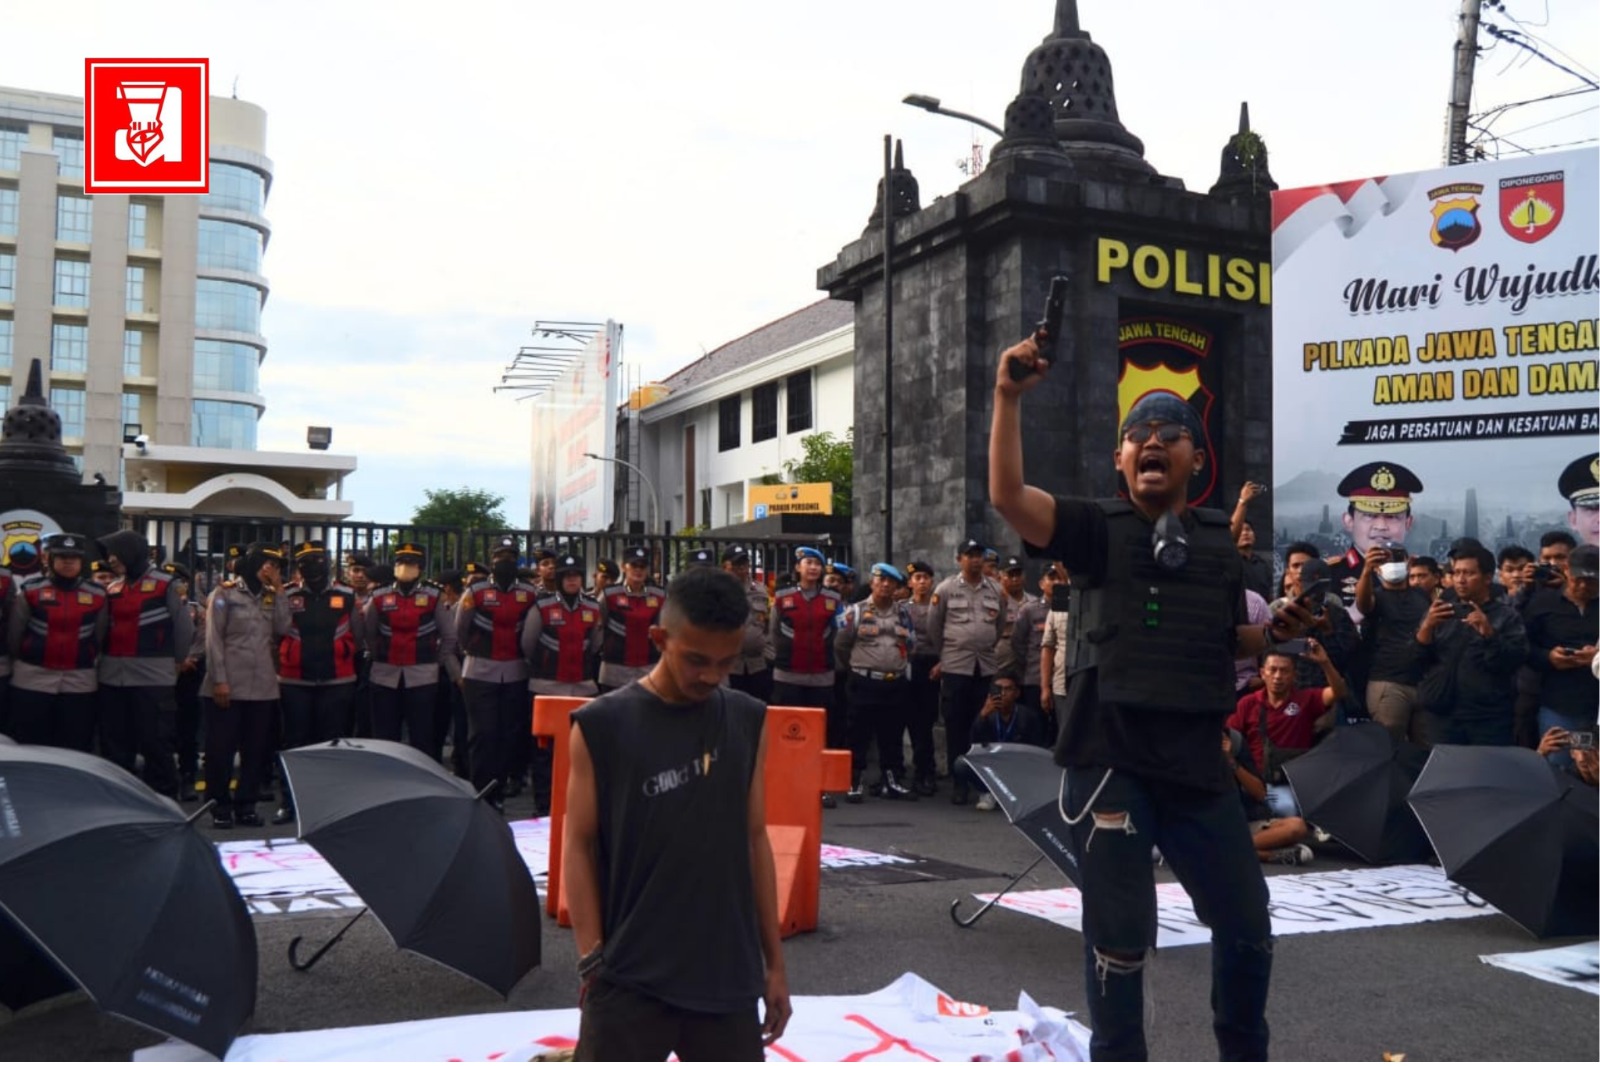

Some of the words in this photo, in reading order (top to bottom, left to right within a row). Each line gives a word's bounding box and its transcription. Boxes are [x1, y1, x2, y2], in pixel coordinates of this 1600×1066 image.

[1500, 172, 1563, 188] DIPONEGORO
[1098, 236, 1271, 305] POLISI
[1343, 274, 1443, 313] Mari
[1118, 323, 1153, 341] JAWA
[1155, 322, 1207, 351] TENGAH
[1303, 335, 1410, 372] PILKADA
[1417, 328, 1497, 363] JAWA
[1373, 370, 1455, 405] AMAN
[1462, 366, 1519, 399] DAN
[1528, 360, 1599, 395] DAM
[1364, 424, 1396, 441] JAGA
[1400, 418, 1472, 439] PERSATUAN
[1476, 417, 1503, 435] DAN
[1508, 413, 1576, 433] KESATUAN
